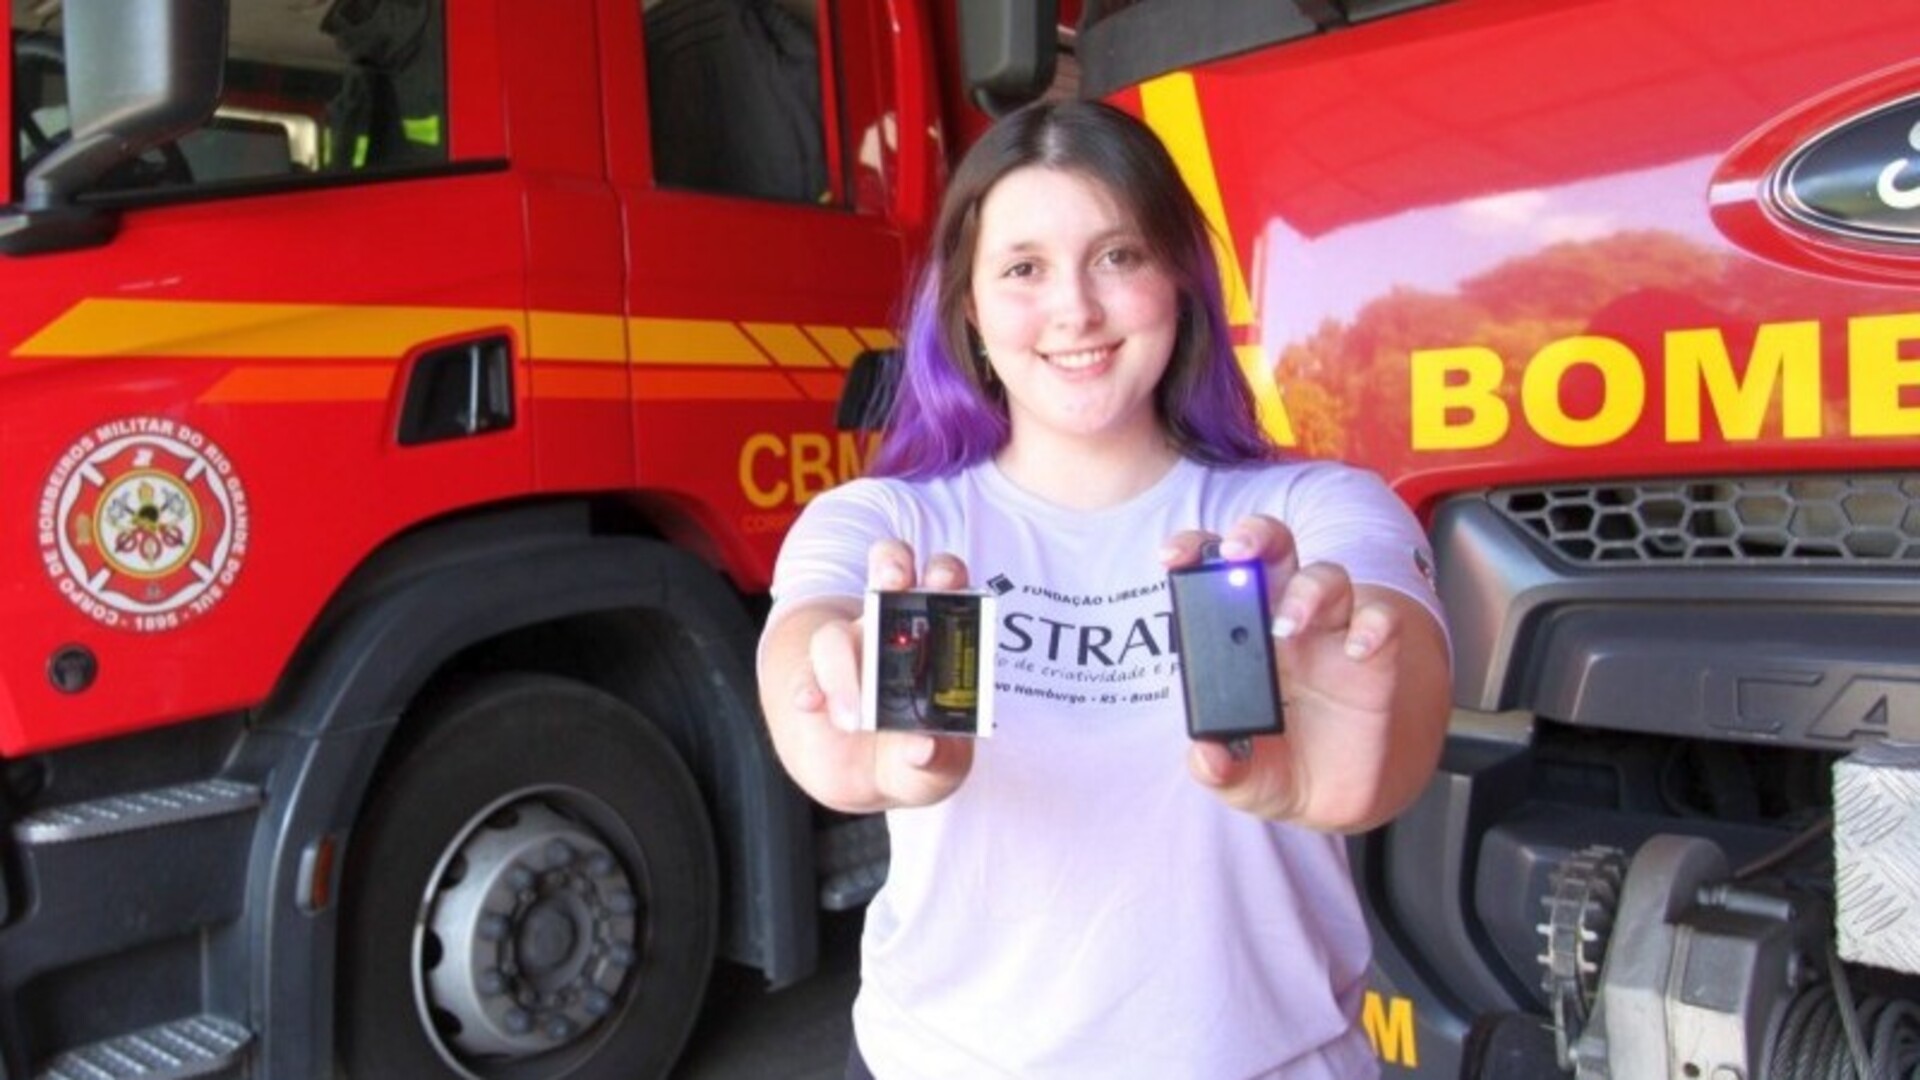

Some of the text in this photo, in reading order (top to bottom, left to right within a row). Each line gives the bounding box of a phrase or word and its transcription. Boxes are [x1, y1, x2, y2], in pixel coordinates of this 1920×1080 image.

[38, 418, 248, 626] CORPO DE BOMBEIROS MILITAR DO RIO GRANDE DO SUL
[1022, 584, 1103, 607] FUNDAÇÃO
[1041, 663, 1146, 683] criatividade
[1014, 684, 1086, 704] Hamburgo
[1100, 692, 1117, 704] RS
[1130, 684, 1170, 704] Brasil
